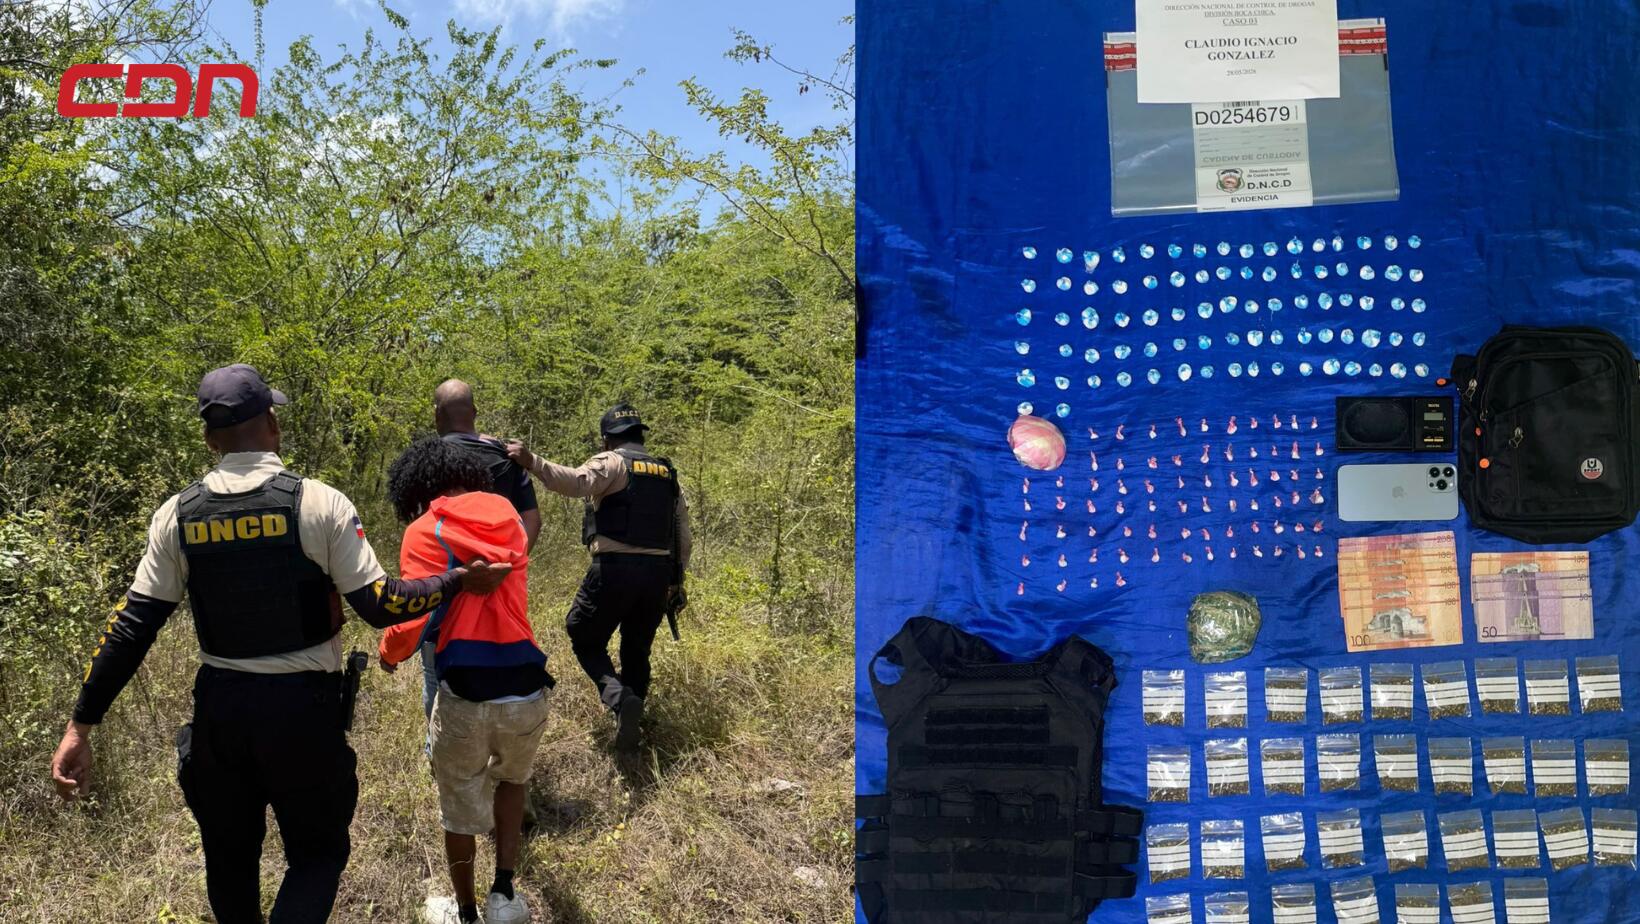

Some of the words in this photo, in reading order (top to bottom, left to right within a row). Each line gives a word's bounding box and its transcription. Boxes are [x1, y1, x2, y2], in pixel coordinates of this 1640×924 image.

[1184, 38, 1241, 49] CLAUDIO
[1244, 36, 1297, 47] IGNACIO
[1207, 50, 1276, 61] GONZALEZ
[1195, 106, 1290, 125] D0254679
[1247, 180, 1292, 190] D.N.C.D
[1231, 194, 1279, 203] EVIDENCIA
[184, 513, 288, 545] DNCD
[1482, 626, 1498, 638] 50
[1350, 634, 1371, 647] 100
